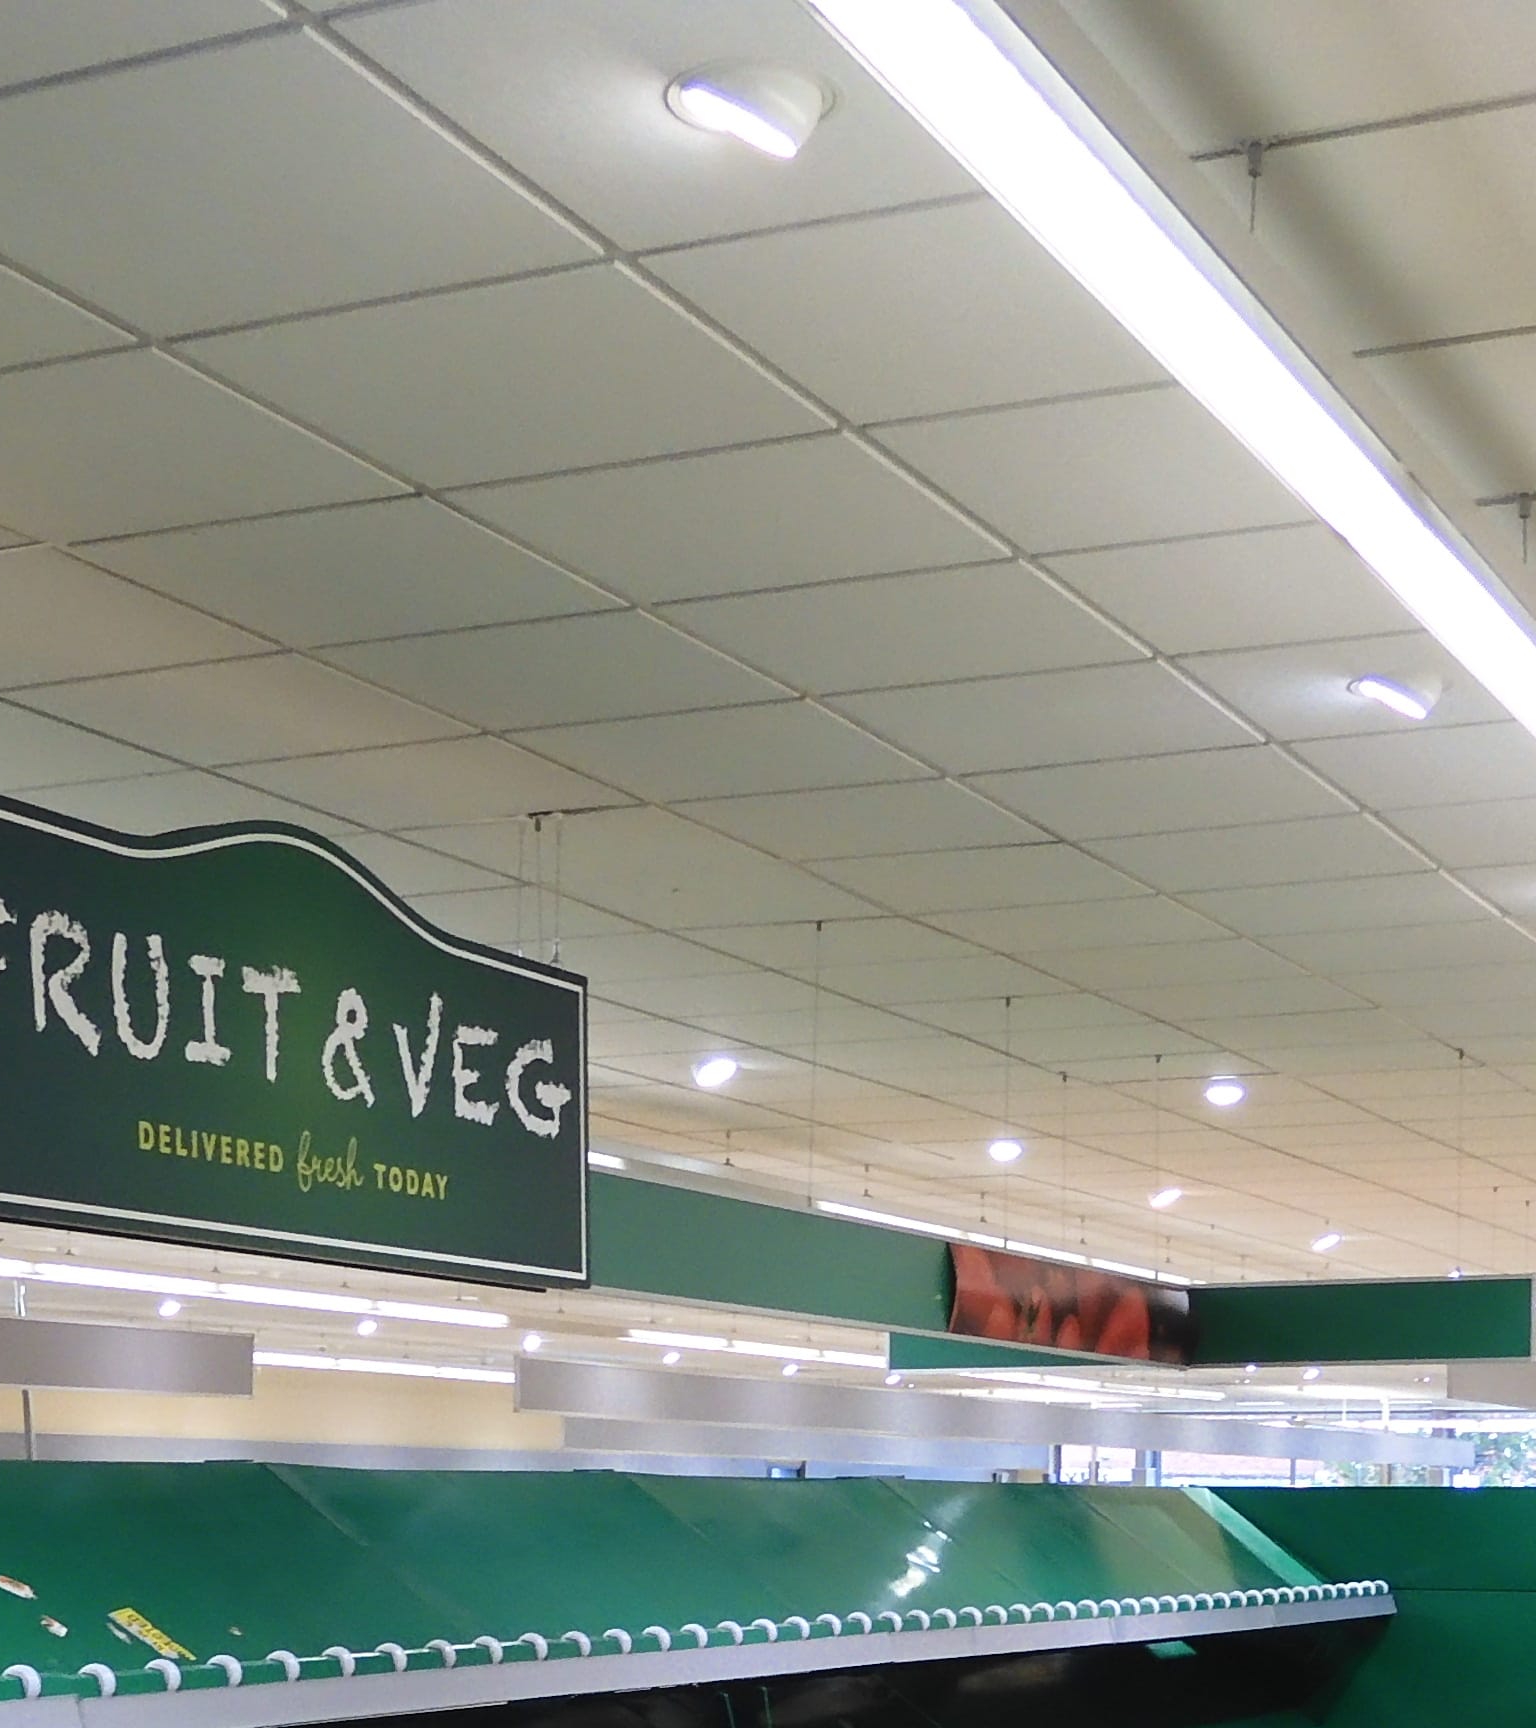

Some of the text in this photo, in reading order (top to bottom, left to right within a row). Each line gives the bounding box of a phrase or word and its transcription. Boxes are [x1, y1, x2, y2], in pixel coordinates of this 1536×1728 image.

[321, 987, 376, 1109] &
[392, 992, 572, 1140] VEG
[137, 1120, 449, 1202] DELIVERED fresh TODAY
